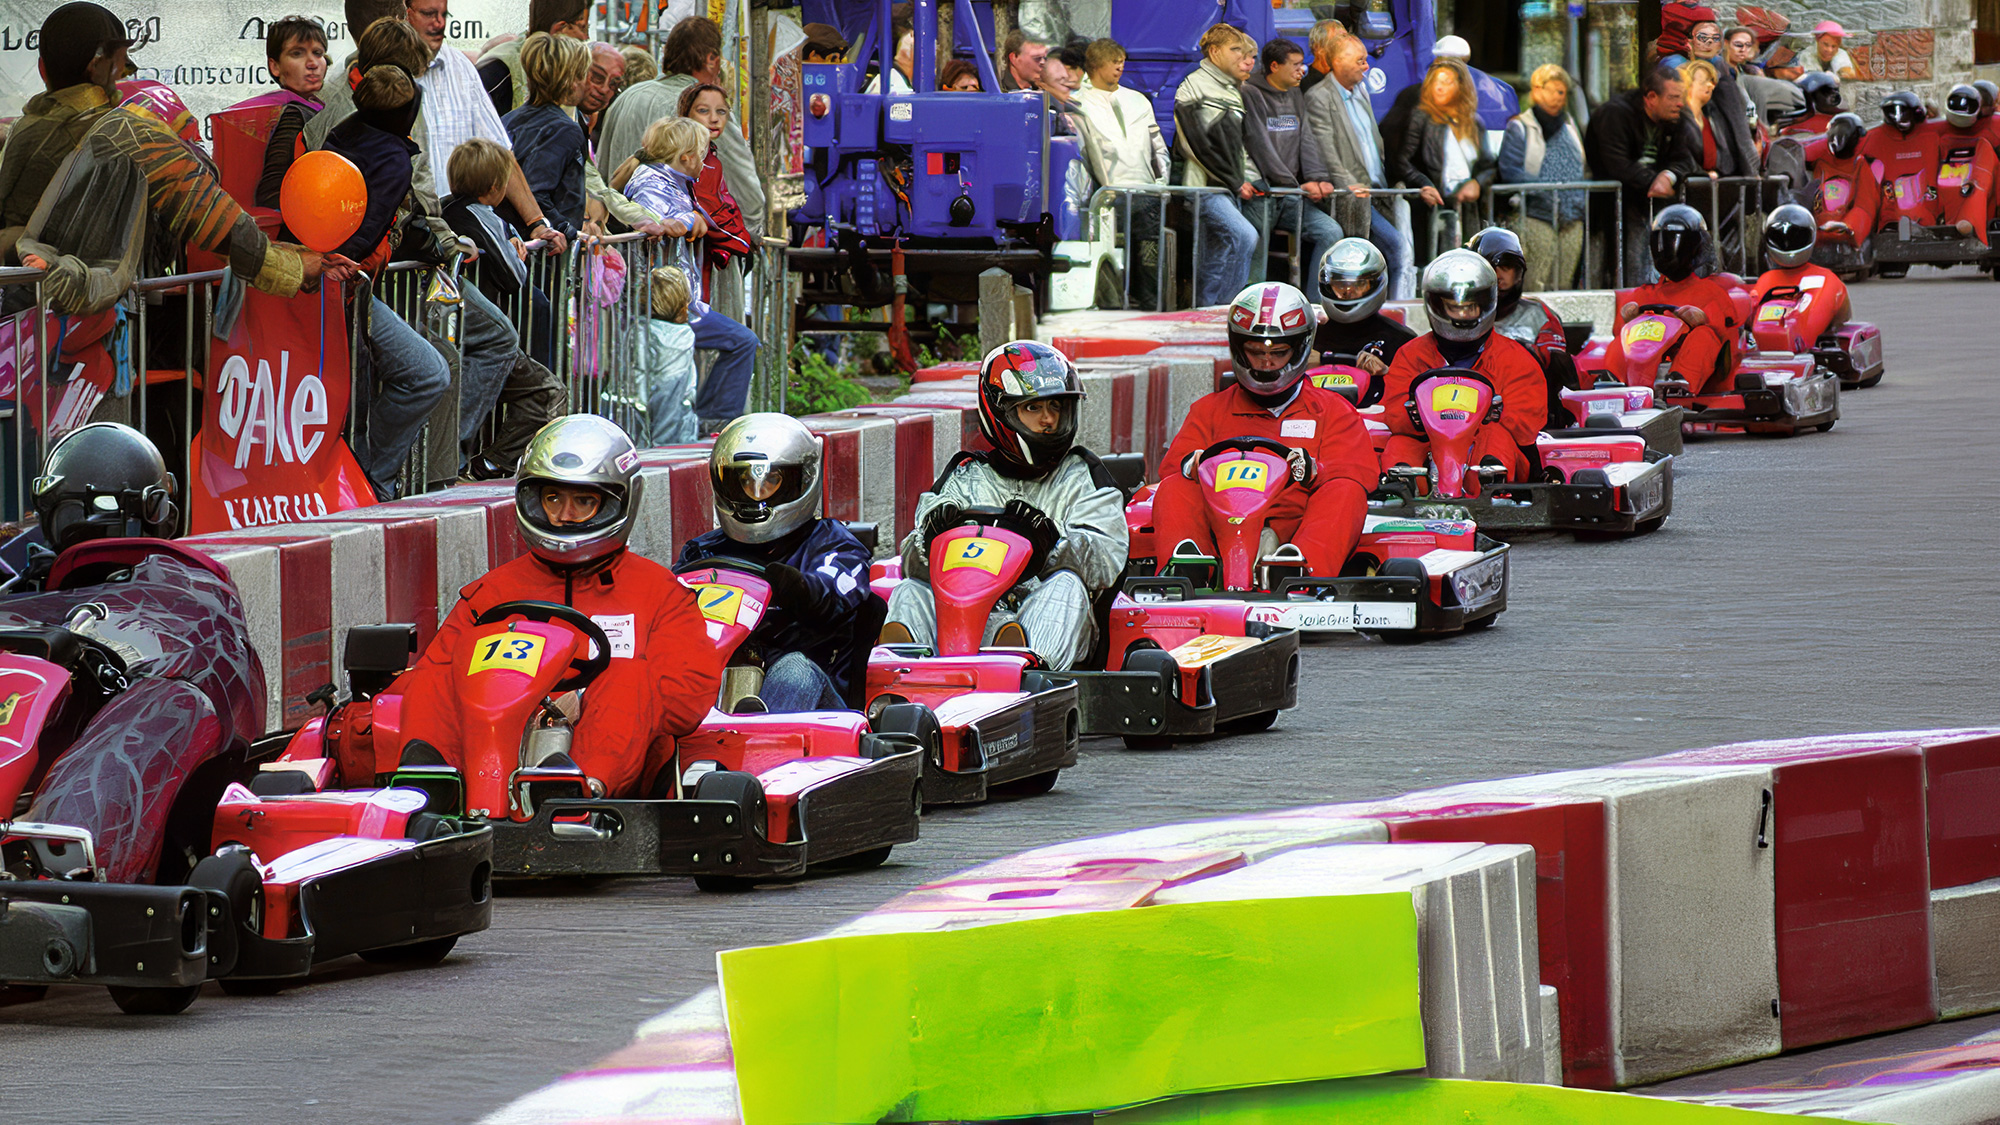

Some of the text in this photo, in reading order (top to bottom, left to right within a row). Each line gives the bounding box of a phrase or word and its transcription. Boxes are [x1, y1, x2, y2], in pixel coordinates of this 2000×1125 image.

[1226, 466, 1261, 481] 16
[961, 541, 989, 559] 5
[482, 637, 535, 662] 13
